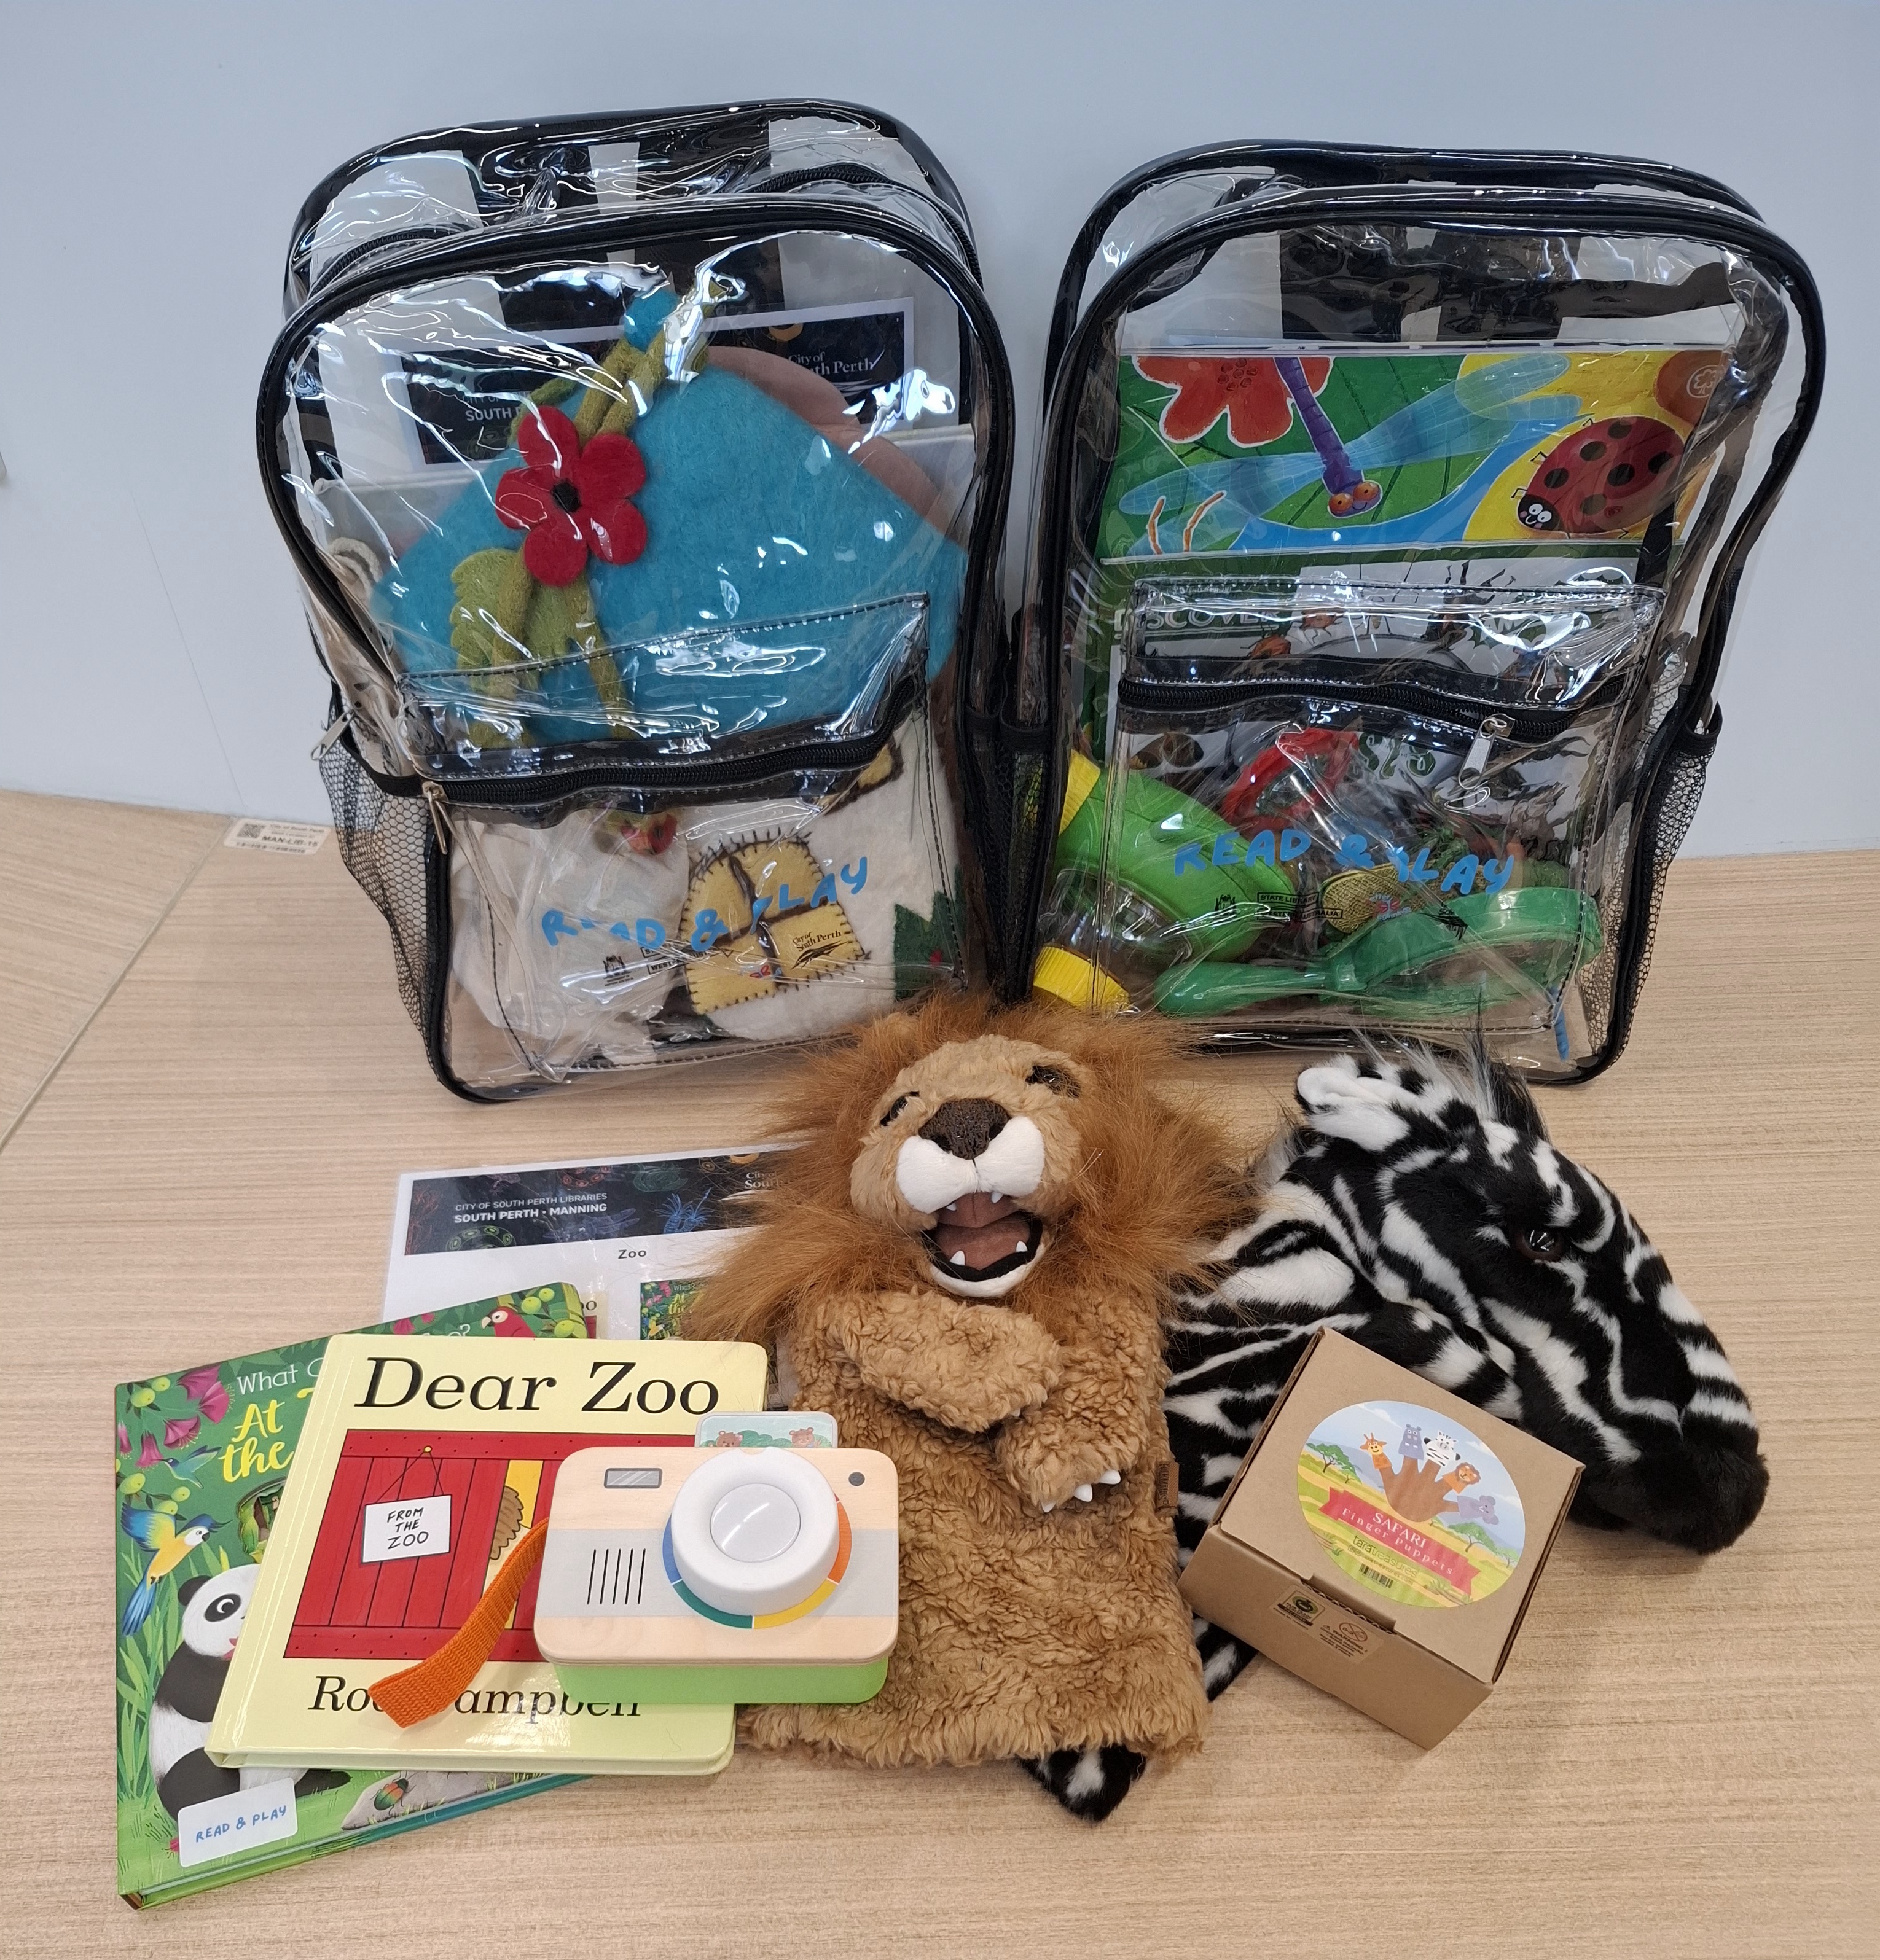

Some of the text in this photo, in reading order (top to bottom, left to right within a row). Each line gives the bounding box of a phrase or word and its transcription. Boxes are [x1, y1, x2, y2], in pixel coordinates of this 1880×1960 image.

[788, 351, 826, 365] City of
[833, 357, 874, 373] Perth
[465, 407, 512, 421] SOUTH
[1173, 829, 1310, 876] READ
[1335, 834, 1374, 870] &
[1285, 894, 1317, 904] LIBRARY
[690, 908, 729, 952] &
[817, 930, 842, 943] Perth
[493, 1200, 525, 1209] SOUTH
[527, 1197, 557, 1206] PERTH
[560, 1193, 608, 1203] LIBRARIES
[455, 1203, 607, 1224] SOUTH PERTH MANNING
[617, 1249, 647, 1259] Zoo
[237, 1364, 299, 1396] What
[354, 1356, 719, 1415] Dear Zoo
[232, 1399, 286, 1442] At
[218, 1437, 294, 1482] the
[387, 1507, 424, 1523] FROM
[395, 1518, 420, 1533] THE
[1373, 1512, 1428, 1549] SAFARI
[388, 1531, 429, 1550] ZOO
[1342, 1507, 1454, 1575] Finger Puppets
[1333, 1630, 1364, 1650] WARNING
[307, 1675, 383, 1712] Ro
[196, 1805, 287, 1843] READ & PLAY
